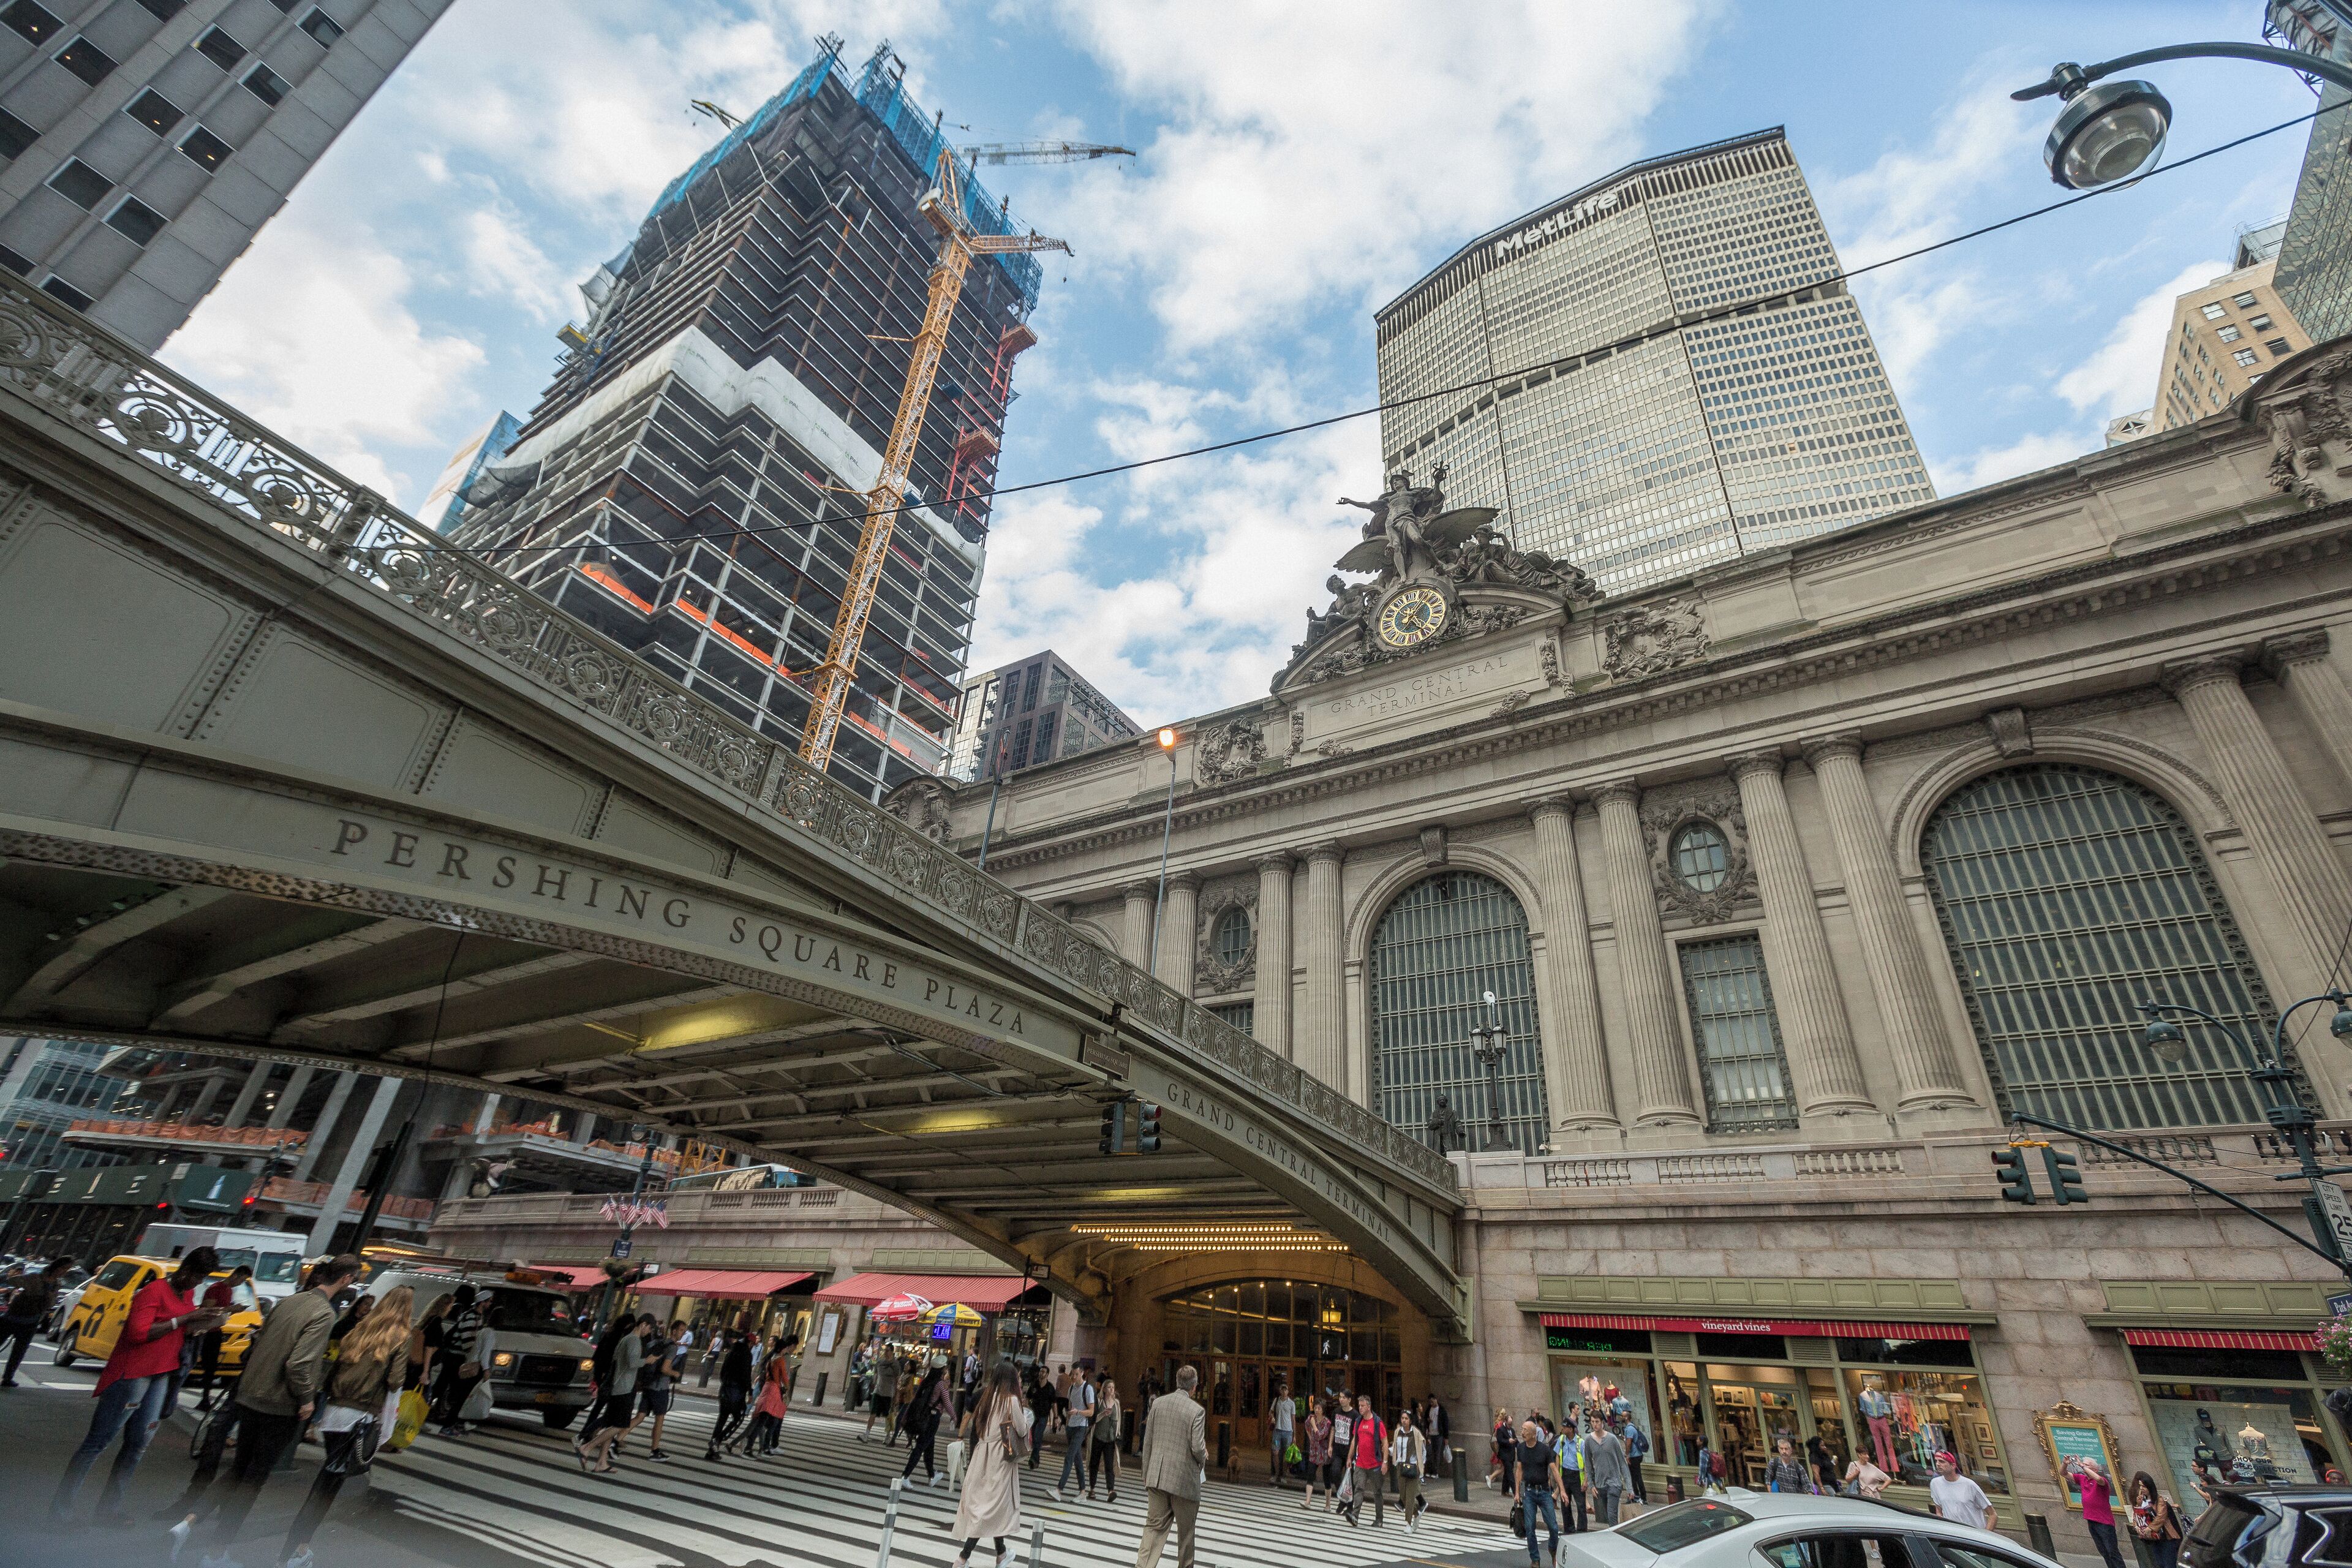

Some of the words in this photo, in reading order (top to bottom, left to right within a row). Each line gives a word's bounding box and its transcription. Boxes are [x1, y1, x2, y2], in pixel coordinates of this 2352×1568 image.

[1497, 192, 1618, 258] MetLife
[789, 401, 799, 410] PAL
[820, 428, 830, 439] PAL
[850, 456, 859, 466] PAL
[1331, 687, 1396, 713] GRAND
[1412, 657, 1508, 690] CENTRAL
[1367, 682, 1469, 716] TERMINAL
[330, 819, 690, 928] PERSHING
[729, 917, 897, 989] SQUARE
[924, 978, 1023, 1034] PLAZA
[1087, 1047, 1109, 1061] PERSHING
[1110, 1058, 1128, 1069] SQUARE
[1167, 1083, 1234, 1131] GRAND
[1246, 1127, 1317, 1185] CENTRAL
[1325, 1179, 1390, 1243] TERMINAL
[2324, 1194, 2341, 1203] SPEED
[2329, 1203, 2343, 1212] LIMIT
[2332, 1213, 2352, 1236] 25
[2334, 1300, 2347, 1313] Park
[1702, 1321, 1744, 1332] vineyard
[1744, 1323, 1771, 1332] vines
